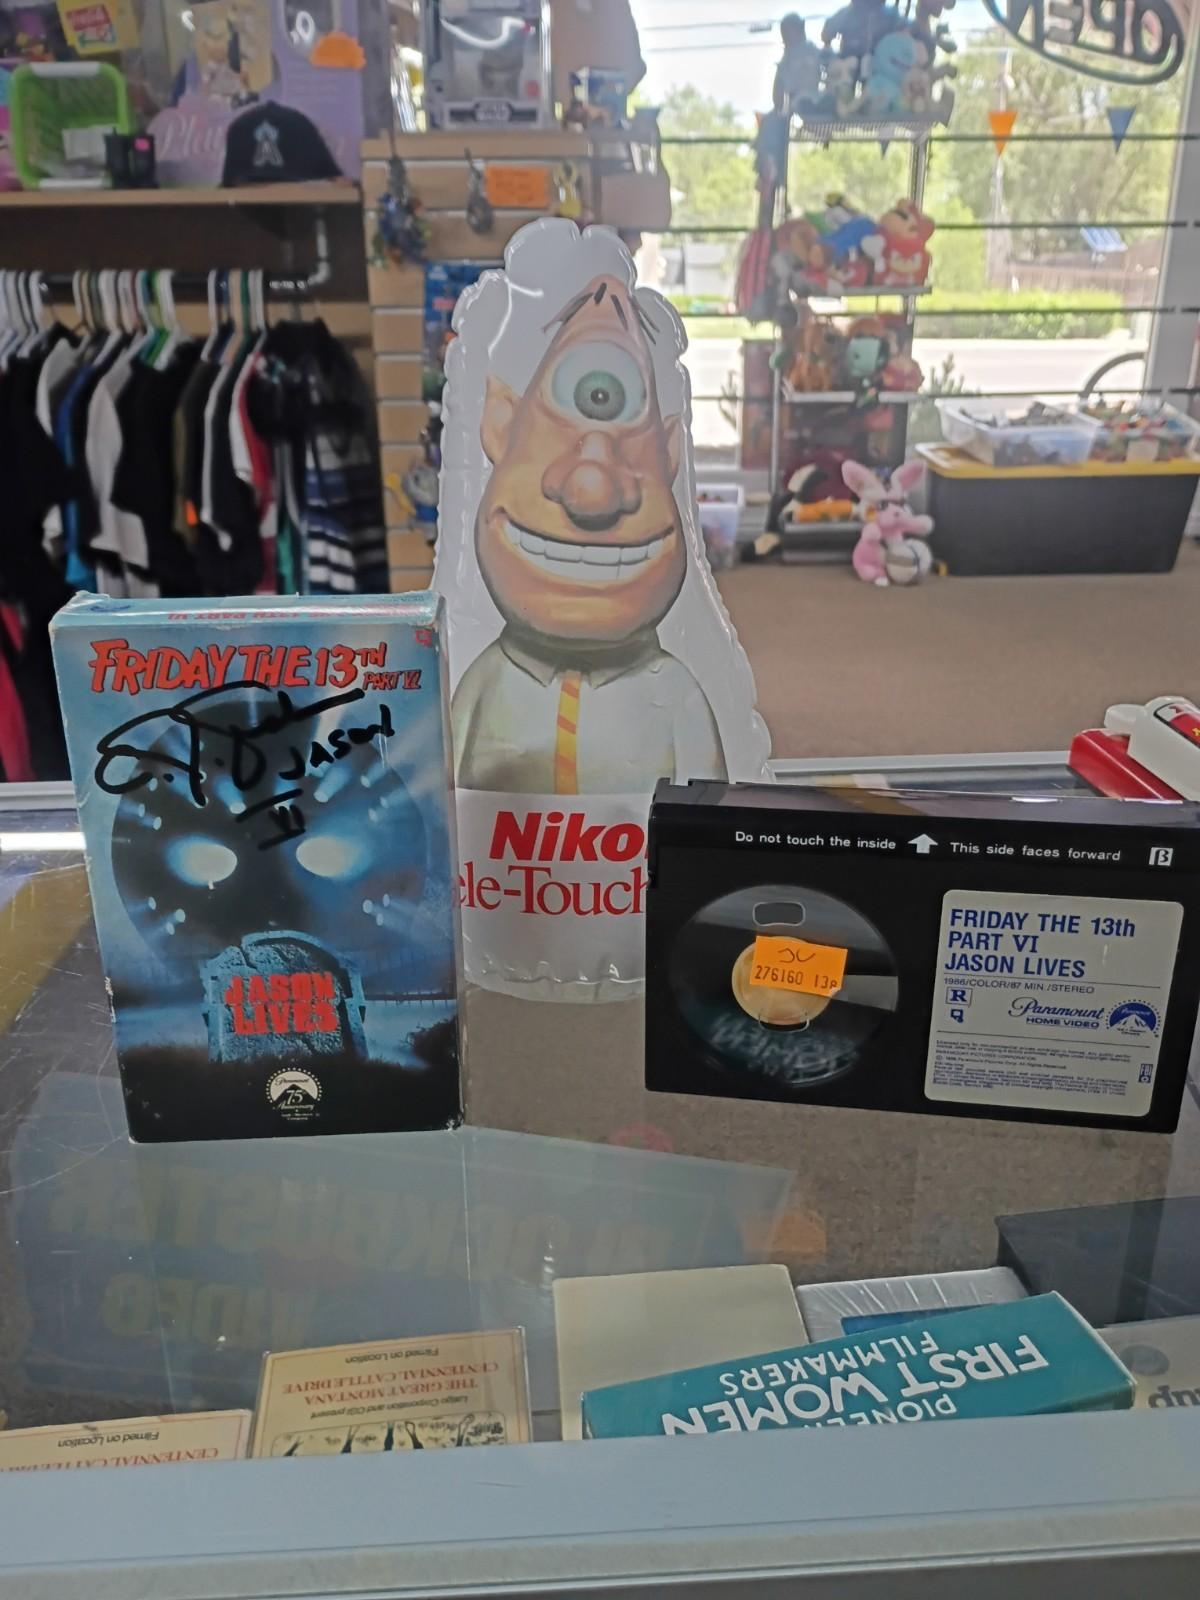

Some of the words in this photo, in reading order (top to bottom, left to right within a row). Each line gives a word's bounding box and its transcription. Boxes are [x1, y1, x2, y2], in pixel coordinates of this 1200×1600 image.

[88, 638, 239, 696] FRIDAY
[236, 643, 312, 690] THE
[313, 641, 388, 689] 13TH
[361, 669, 401, 692] PART
[402, 668, 423, 691] VI
[279, 704, 395, 781] JASON
[488, 810, 648, 862] Niko
[735, 830, 754, 844] Do
[758, 832, 782, 846] not
[786, 833, 825, 848] touch
[829, 835, 852, 849] the
[856, 836, 897, 851] inside
[949, 841, 981, 856] This
[986, 842, 1016, 857] side
[1021, 844, 1061, 860] faces
[1067, 846, 1122, 863] forward
[949, 908, 1030, 932] FRIDAY
[1037, 912, 1081, 935] THE
[1091, 916, 1136, 938] 13th
[947, 931, 1004, 952] PART
[1013, 934, 1040, 954] VI
[754, 965, 805, 986] 276160
[944, 953, 1015, 975] JASON
[1023, 957, 1087, 979] LIVES
[225, 972, 336, 1006] JASON
[949, 989, 968, 1003] R
[1008, 995, 1106, 1019] Paramount
[230, 1001, 338, 1036] LIVES
[1025, 1016, 1062, 1027] HOME
[1063, 1019, 1100, 1030] VIDEO
[344, 1352, 388, 1365] Location
[389, 1351, 404, 1361] on
[406, 1347, 440, 1359] Filmed
[719, 1330, 939, 1396] FILMMAKERS
[398, 1361, 499, 1382] CENTENNIAL
[900, 1333, 1050, 1398] FIRST
[283, 1378, 334, 1395] DRIVE
[334, 1371, 397, 1388] CATTLE
[386, 1380, 443, 1397] GREAT
[444, 1377, 478, 1392] THE
[304, 1387, 385, 1406] MONTANA
[385, 1397, 440, 1411] Corporation
[661, 1371, 888, 1437] WOMEN
[310, 1407, 346, 1420] present
[366, 1403, 385, 1413] and
[803, 1393, 958, 1428] PIONE
[58, 1434, 105, 1449] Location
[106, 1434, 121, 1444] on
[121, 1430, 160, 1444] Filmed
[110, 1446, 220, 1468] CENTENNIAL
